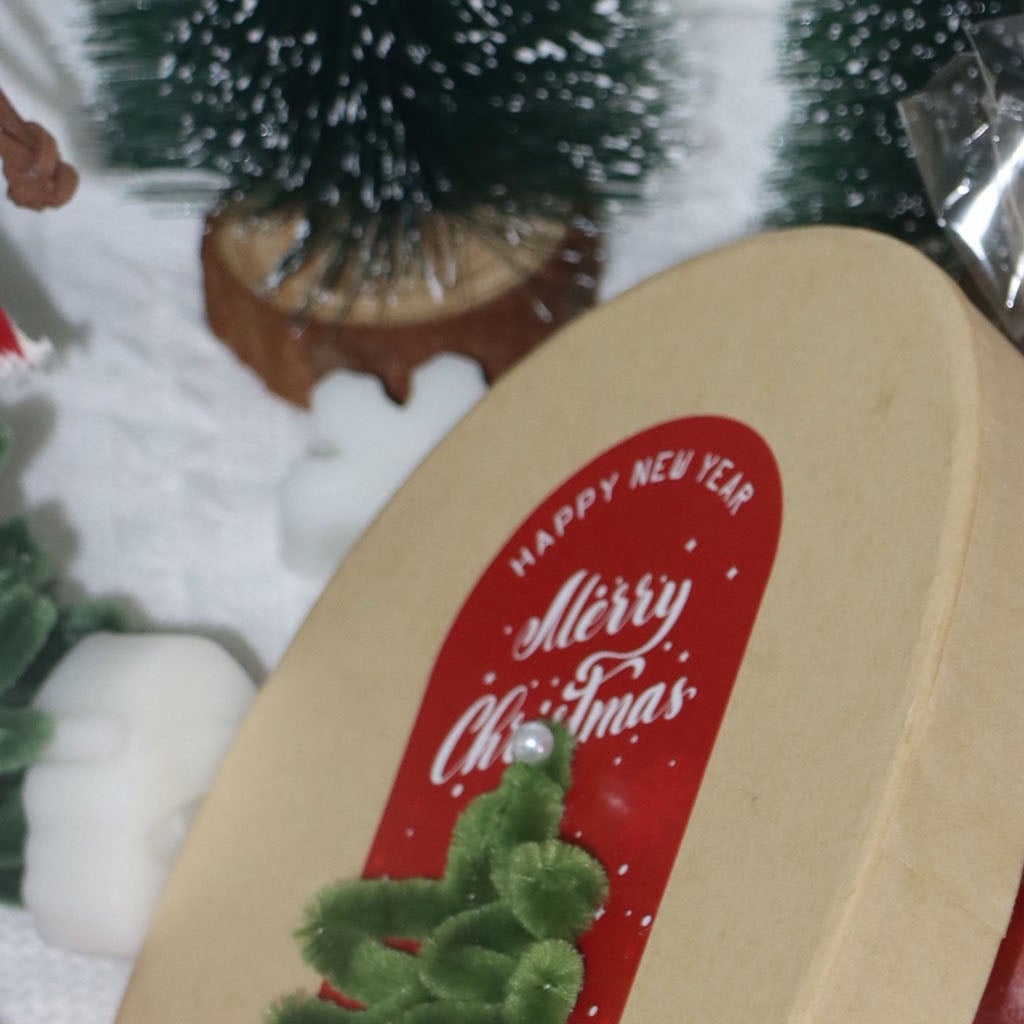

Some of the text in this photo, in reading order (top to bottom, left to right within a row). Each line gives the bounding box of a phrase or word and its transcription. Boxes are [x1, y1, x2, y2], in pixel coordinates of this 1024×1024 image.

[508, 449, 755, 577] HAPPY NEW YEAR
[513, 569, 692, 664] Merry
